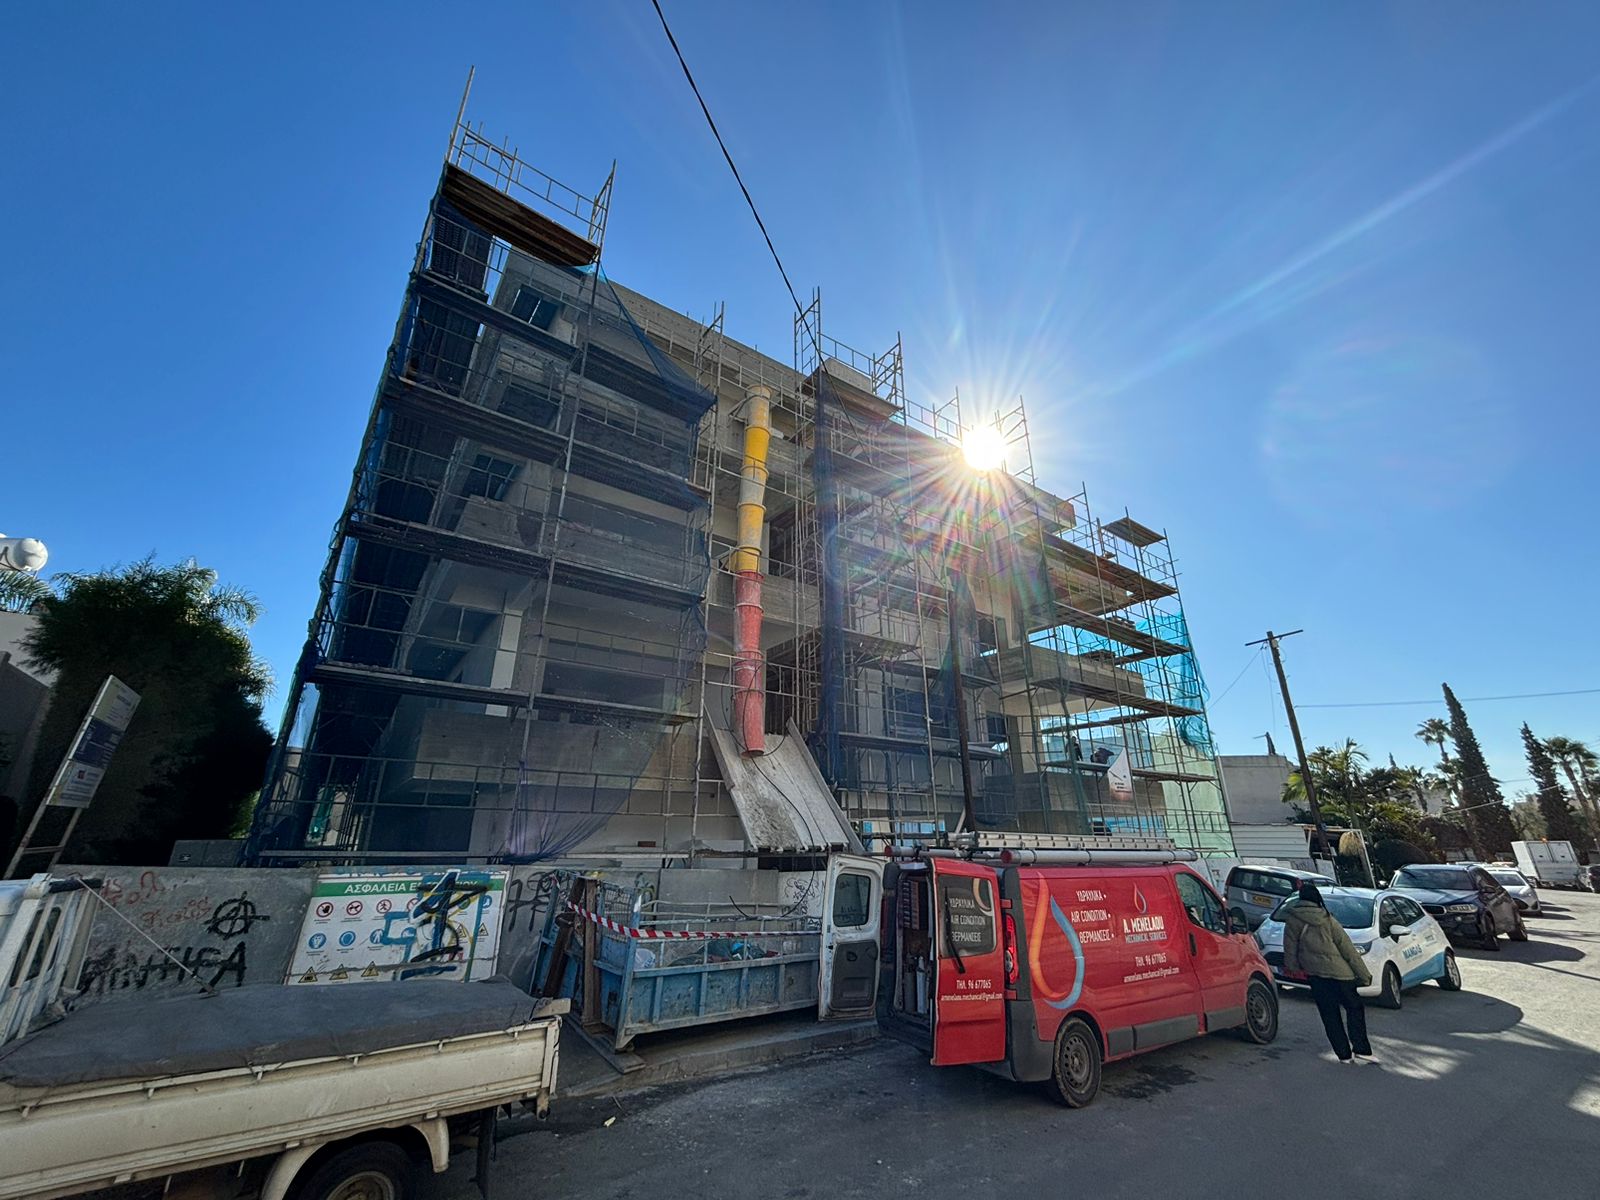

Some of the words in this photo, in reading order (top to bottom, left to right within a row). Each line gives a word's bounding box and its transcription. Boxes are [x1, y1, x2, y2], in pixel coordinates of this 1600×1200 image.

[344, 882, 407, 894] ΑΣΦΑΛΕΙΑ
[960, 915, 986, 925] CONDITION
[1071, 911, 1080, 923] AIR
[1080, 909, 1108, 922] CONDITION
[1123, 919, 1131, 933] A.
[1131, 916, 1165, 932] MENELAOU
[1125, 932, 1149, 944] MECHANICAL
[1149, 931, 1168, 941] SERVICES
[967, 980, 974, 989] 96
[974, 979, 992, 989] 677065
